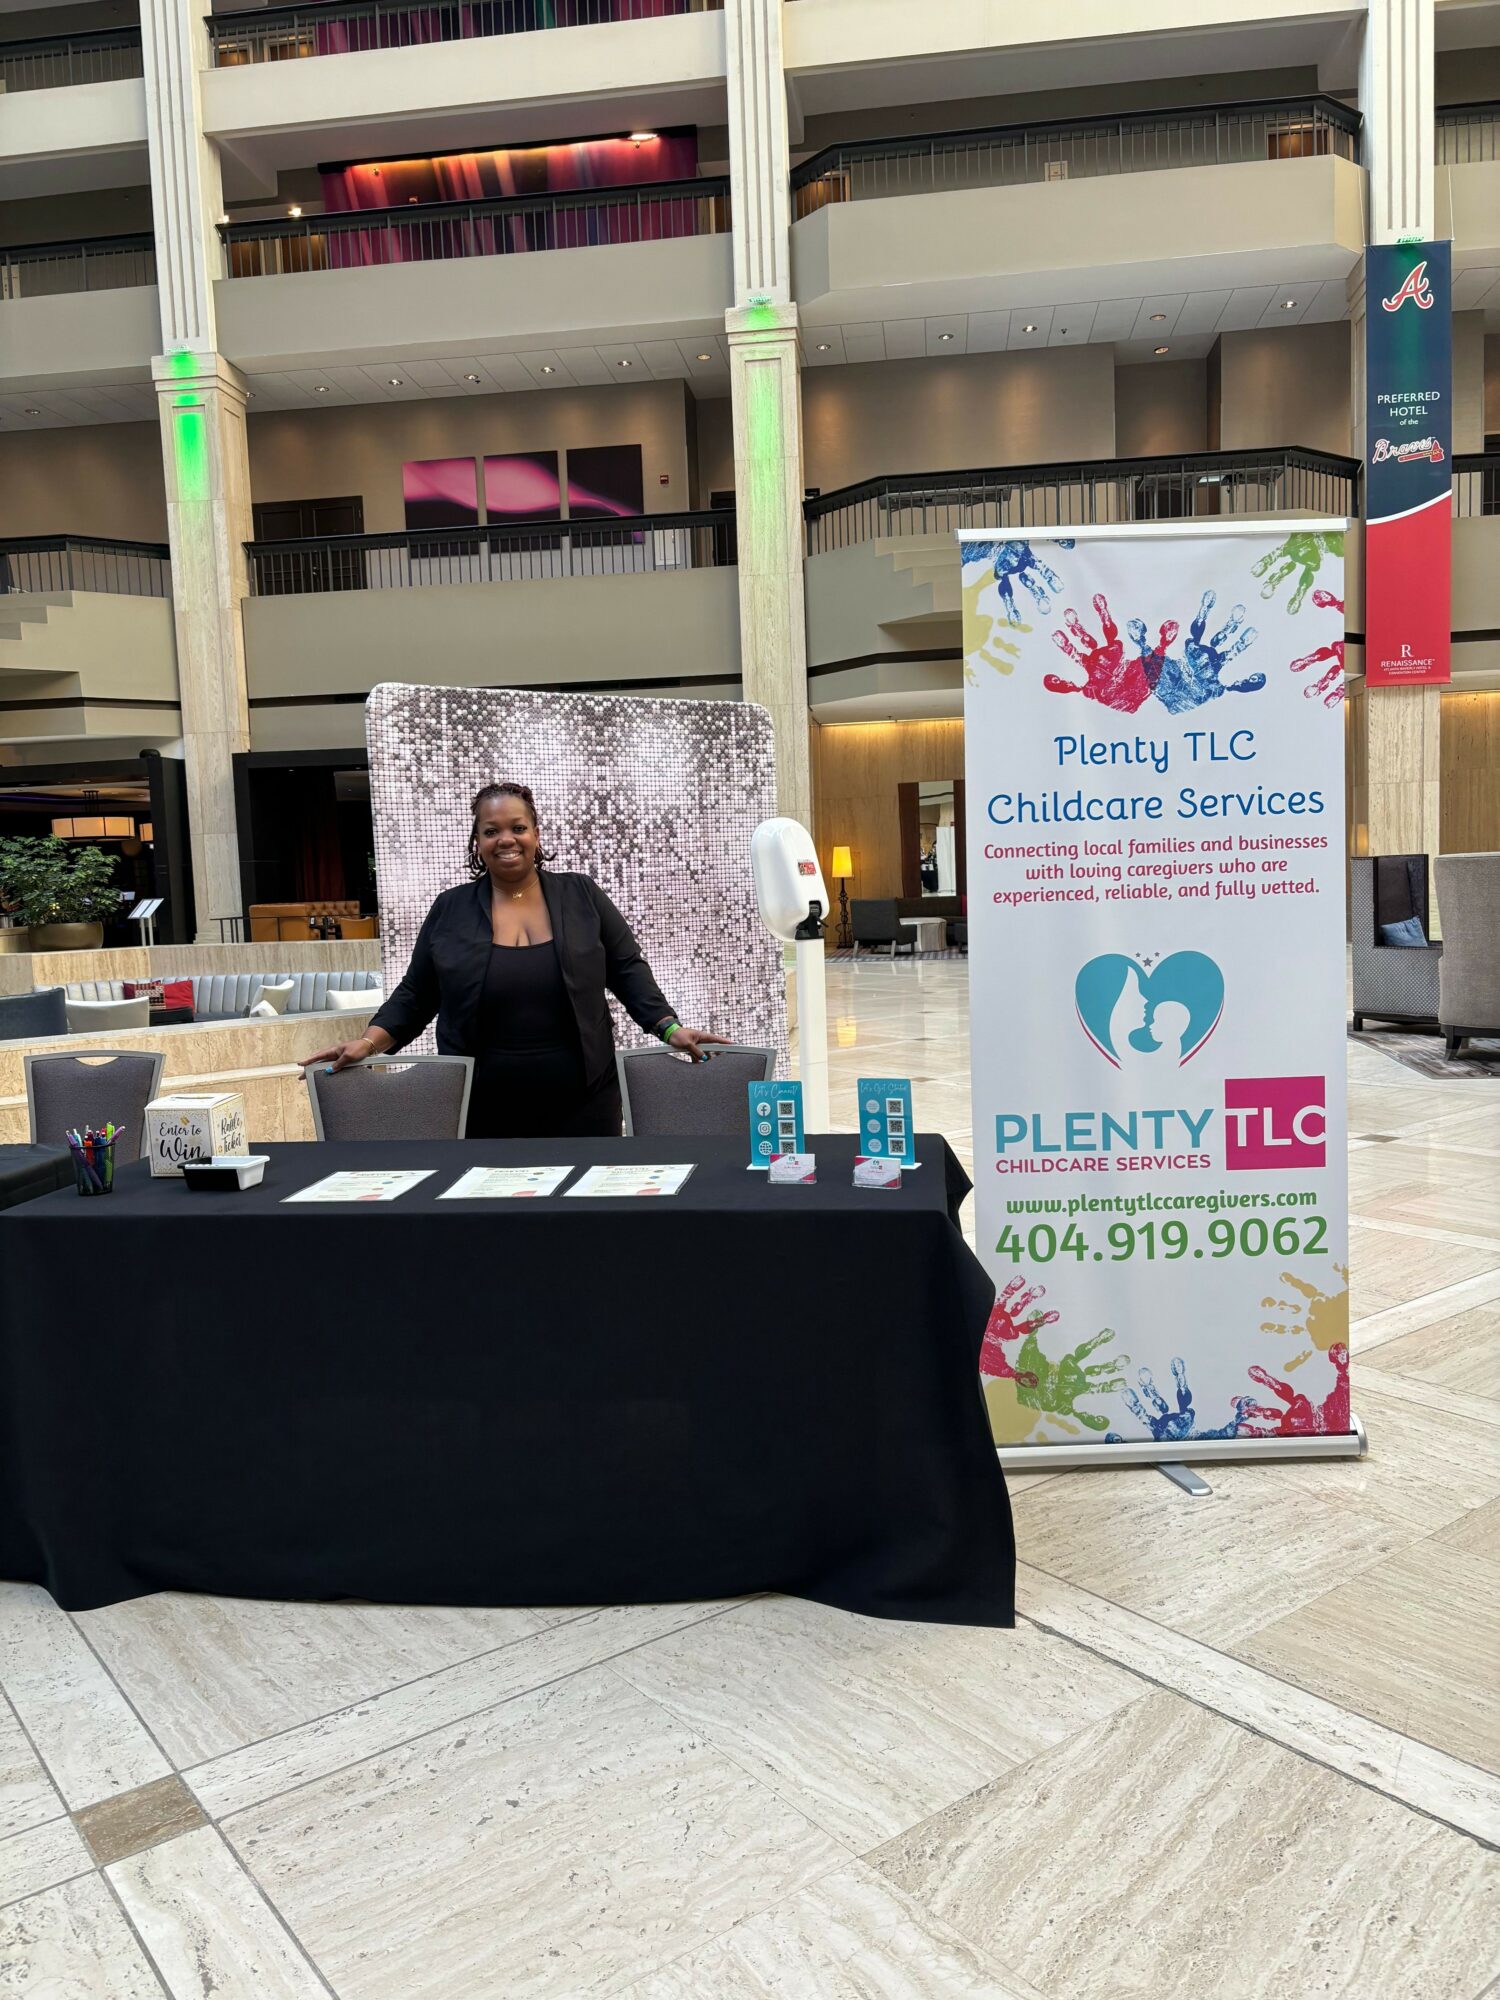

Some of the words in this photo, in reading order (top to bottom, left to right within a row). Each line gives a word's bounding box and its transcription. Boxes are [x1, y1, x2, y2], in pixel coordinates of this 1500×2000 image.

[1382, 260, 1434, 312] A
[1377, 391, 1440, 404] PREFERRED
[1390, 405, 1428, 417] HOTEL
[1399, 418, 1407, 426] of
[1372, 437, 1432, 464] Braves
[1381, 659, 1432, 667] RENAISSANCE
[1400, 644, 1415, 658] R
[1054, 734, 1169, 773] Plenty
[1184, 729, 1257, 762] TLC
[987, 790, 1164, 824] Childcare
[1176, 785, 1325, 819] Services
[984, 841, 1079, 860] Connecting
[1084, 839, 1123, 856] local
[1128, 836, 1195, 858] families
[1200, 835, 1233, 852] and
[1238, 834, 1328, 851] businesses
[1025, 864, 1064, 880] with
[1069, 861, 1122, 882] loving
[1127, 860, 1213, 882] caregivers
[1218, 857, 1256, 874] who
[1261, 859, 1288, 873] are
[993, 885, 1099, 906] experienced,
[1104, 882, 1172, 902] reliable,
[1178, 880, 1210, 898] and
[1215, 879, 1256, 900] fully
[1261, 877, 1320, 895] vetted.
[160, 1122, 190, 1137] Enter
[191, 1124, 202, 1136] to
[995, 1108, 1215, 1153] PLENTY
[1225, 1104, 1326, 1147] TLC
[160, 1137, 204, 1162] Win
[995, 1156, 1109, 1174] CHILDCARE
[1117, 1154, 1211, 1171] SERVICES
[1006, 1189, 1317, 1217] www.plentytlccaregivers.com
[995, 1215, 1329, 1263] 404.919.9062
